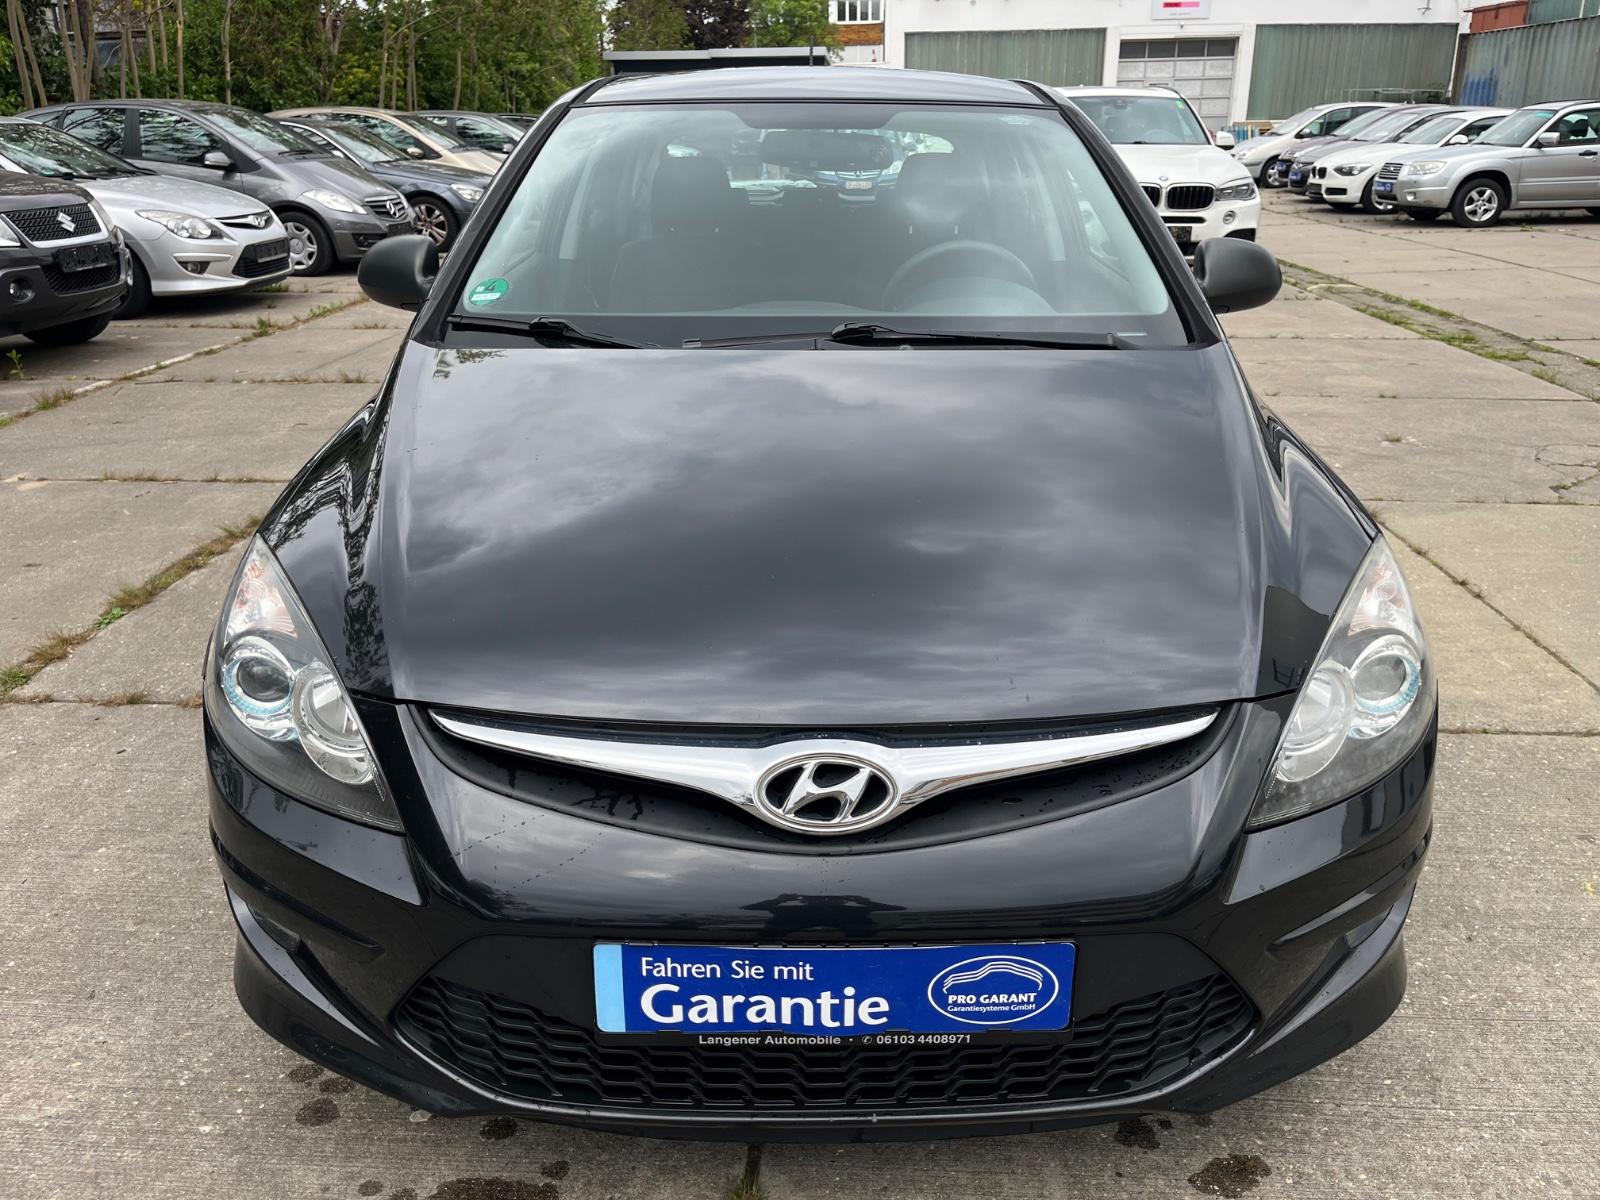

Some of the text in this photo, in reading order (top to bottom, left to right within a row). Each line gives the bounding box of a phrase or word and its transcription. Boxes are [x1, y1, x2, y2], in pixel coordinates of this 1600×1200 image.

[641, 957, 814, 980] Fahren Sie mit
[948, 993, 1037, 1004] PRO GARANT
[641, 983, 890, 1028] Garantie
[947, 1003, 1036, 1013] Garantiesysteme GmbH
[699, 1034, 971, 1046] Langener Automobile 06103 4408971
